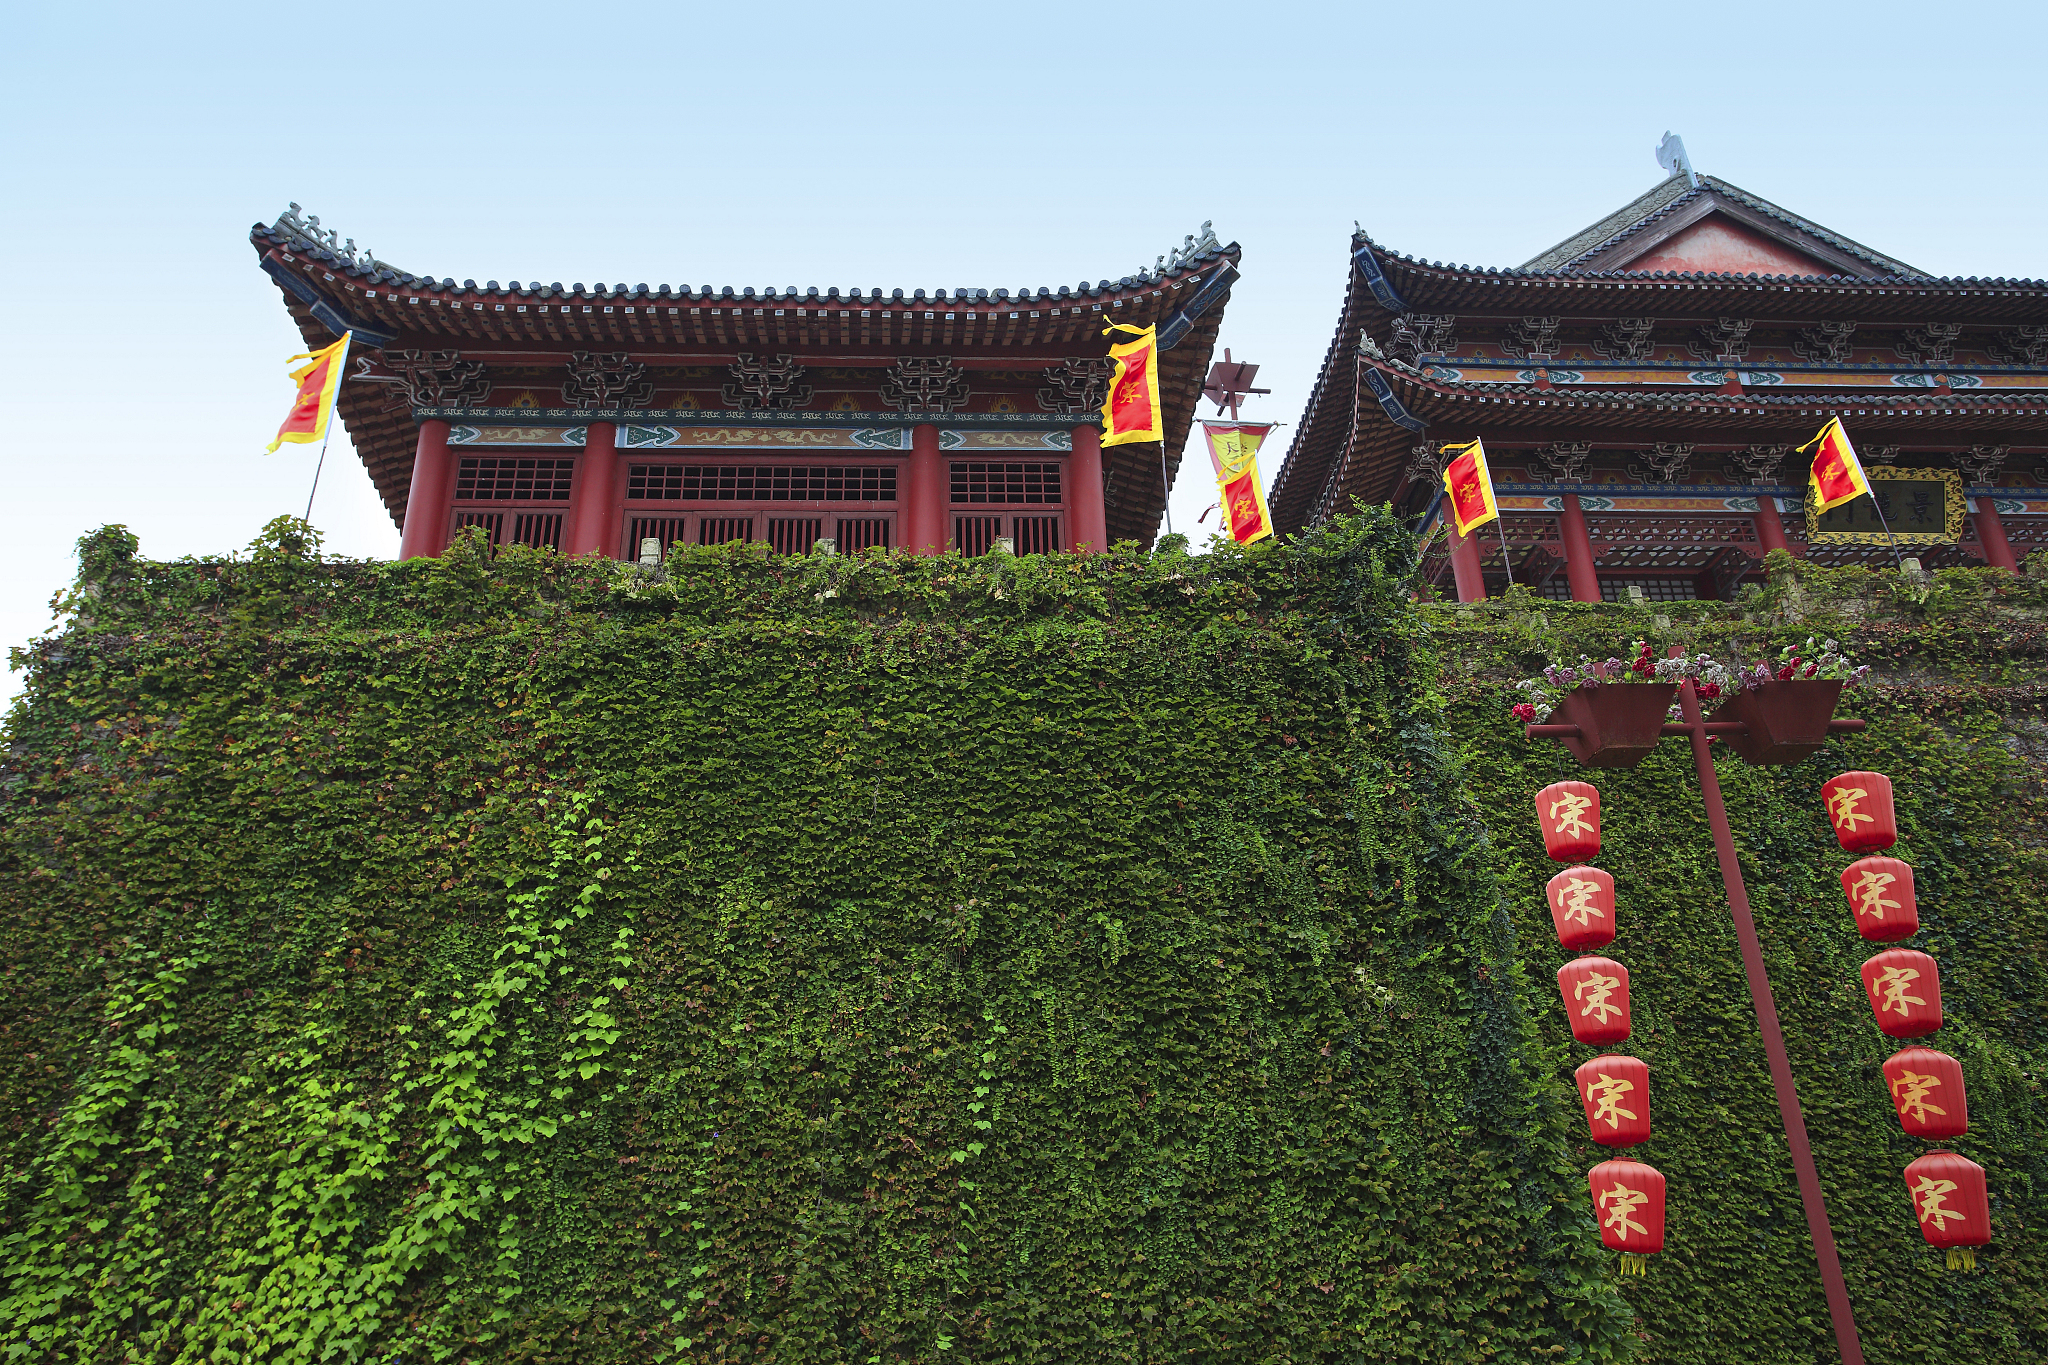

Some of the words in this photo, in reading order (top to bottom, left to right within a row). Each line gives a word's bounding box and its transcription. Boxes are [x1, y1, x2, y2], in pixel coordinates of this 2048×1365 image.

[1119, 381, 1142, 404] 宋
[1235, 500, 1254, 519] 宋
[1460, 484, 1475, 502] 宋
[1550, 792, 1594, 839] 宋
[1828, 787, 1873, 832] 宋
[1557, 877, 1604, 926] 宋
[1852, 871, 1901, 919] 宋
[1574, 971, 1622, 1024] 宋
[1873, 966, 1926, 1016] 宋
[1586, 1073, 1637, 1129] 宋
[1892, 1070, 1946, 1123] 宋
[1599, 1182, 1648, 1240] 宋
[1910, 1175, 1965, 1231] 宋
